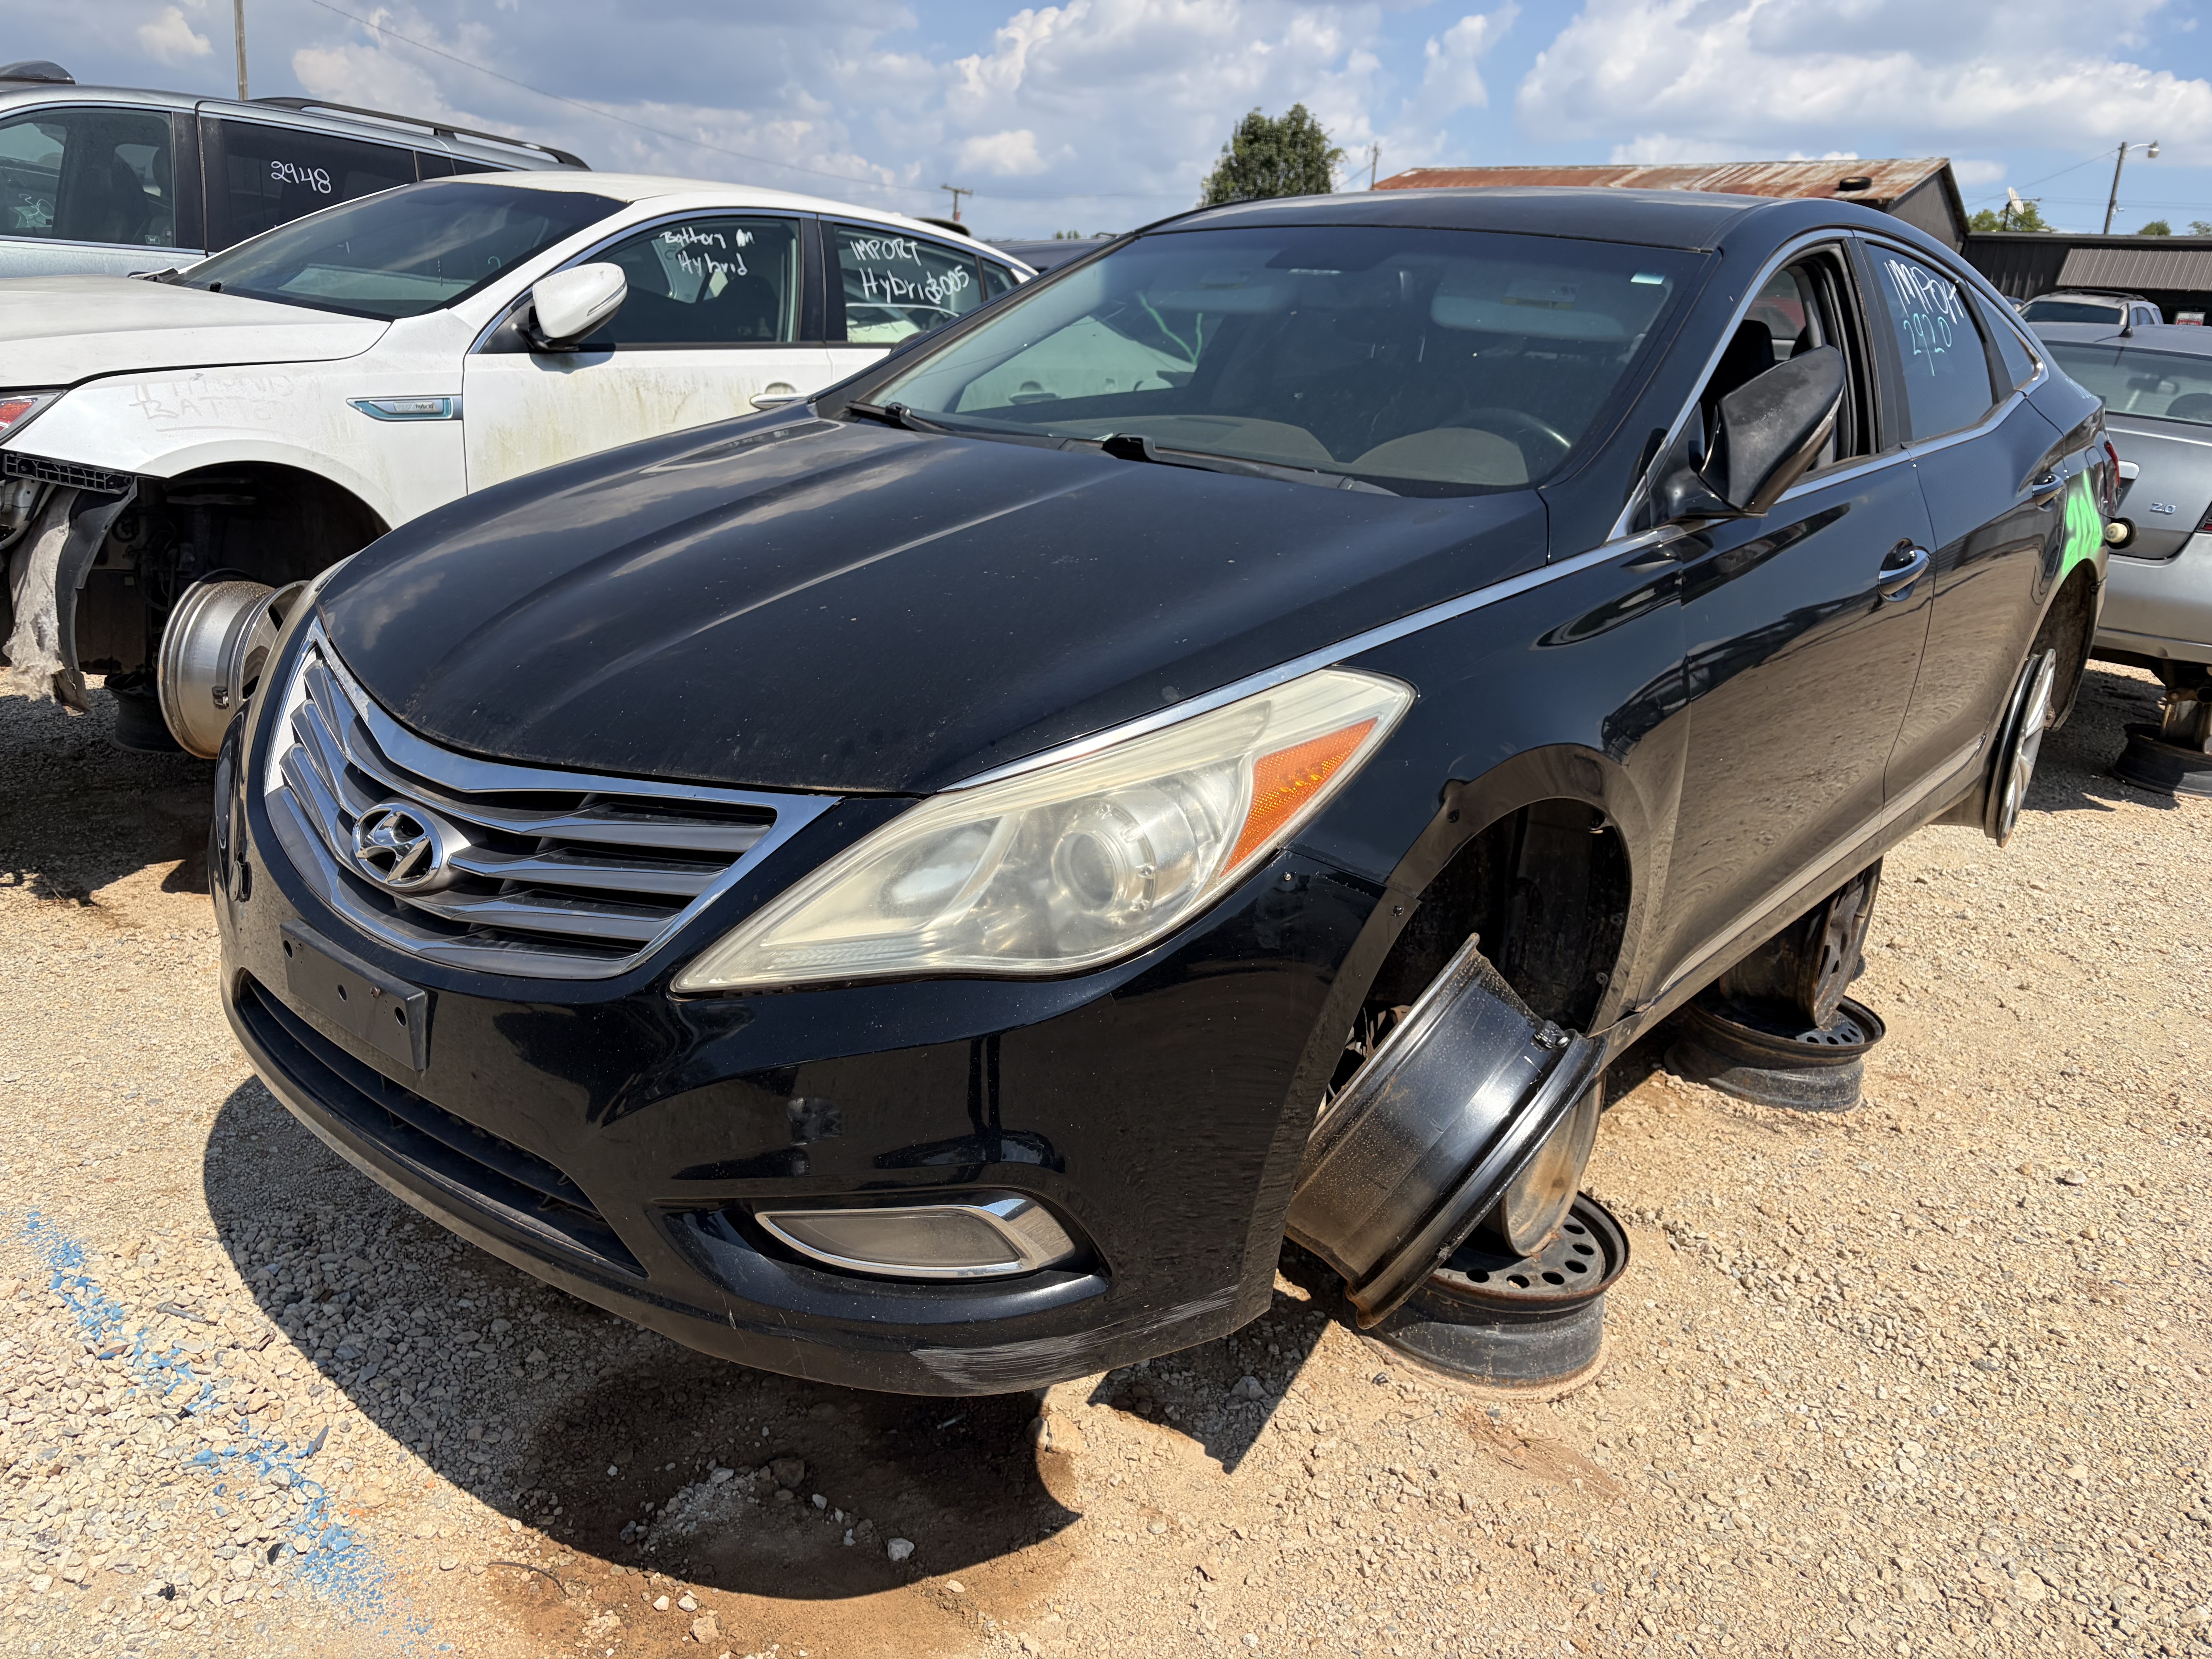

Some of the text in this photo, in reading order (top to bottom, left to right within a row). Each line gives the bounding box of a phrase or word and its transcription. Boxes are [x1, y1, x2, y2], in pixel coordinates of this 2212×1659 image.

[271, 161, 331, 194] 2948
[678, 250, 748, 276] Hybrid
[850, 237, 922, 266] IMPORT
[2151, 502, 2176, 514] 2.0
